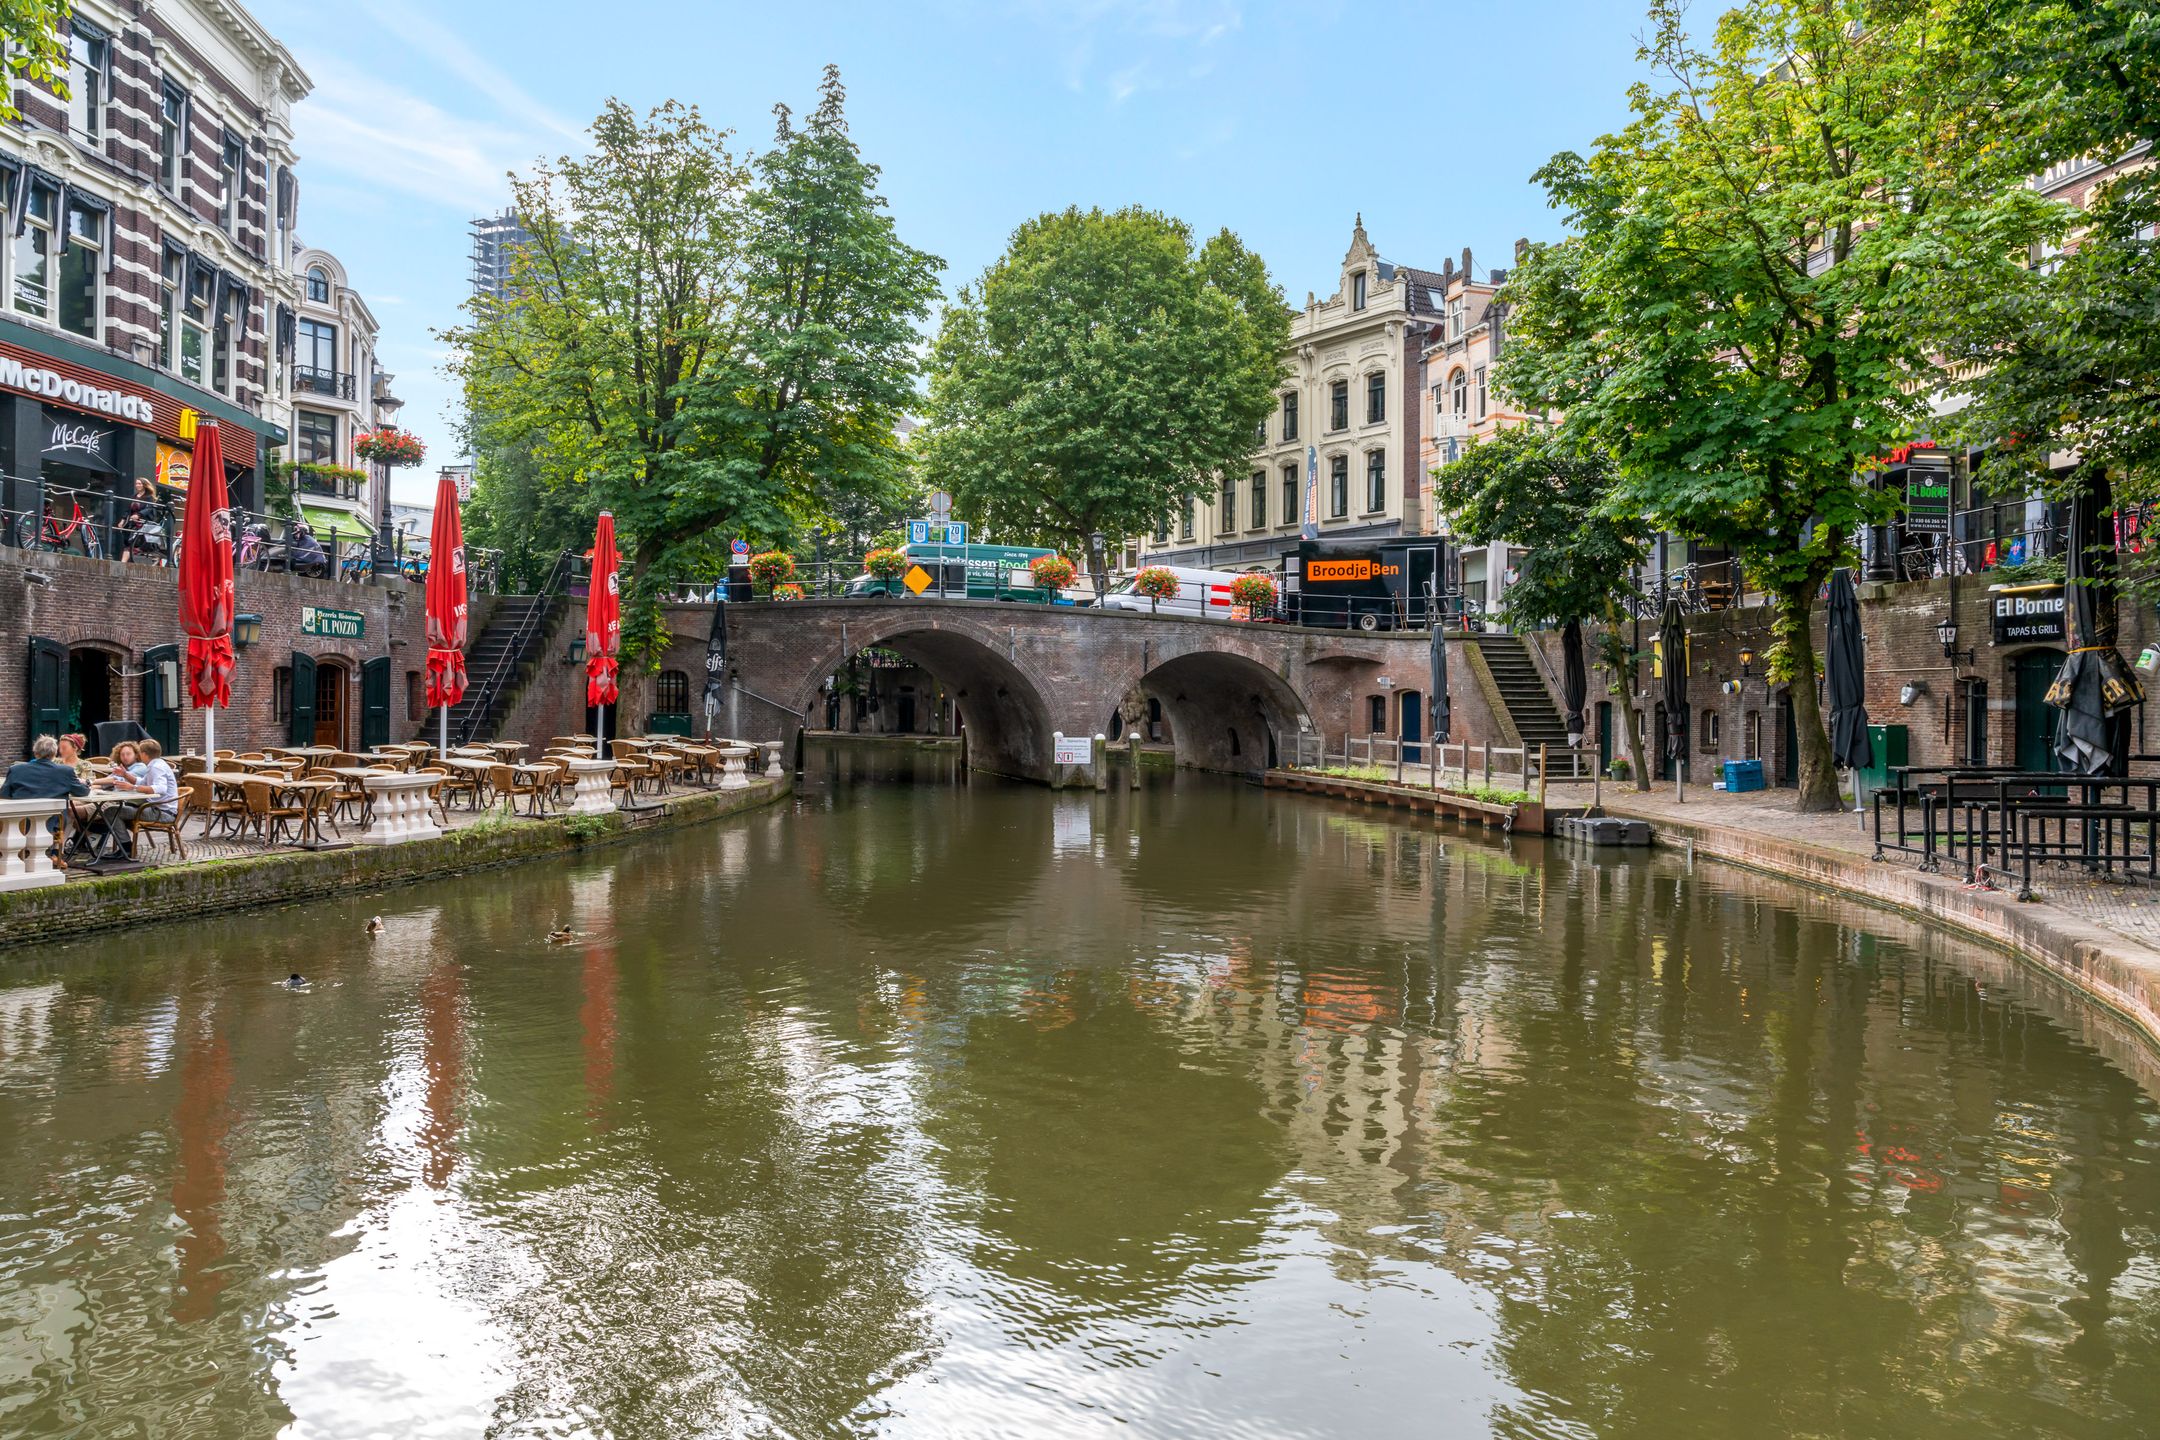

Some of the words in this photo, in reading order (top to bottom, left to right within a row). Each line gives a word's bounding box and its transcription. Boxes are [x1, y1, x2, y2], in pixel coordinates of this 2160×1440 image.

[0, 356, 153, 424] McDonald's
[51, 423, 99, 453] McCafé
[1920, 486, 1948, 498] BORNE
[941, 556, 997, 569] Drissen
[999, 559, 1029, 569] Food
[1313, 563, 1368, 579] Broodje
[1371, 563, 1399, 576] Ben
[1996, 598, 2013, 617] El
[2015, 597, 2065, 616] Borne
[322, 619, 330, 633] IL
[332, 620, 357, 635] POZZO
[2007, 626, 2030, 637] TAPAS
[2031, 625, 2038, 635] &
[2038, 624, 2060, 634] GRILL
